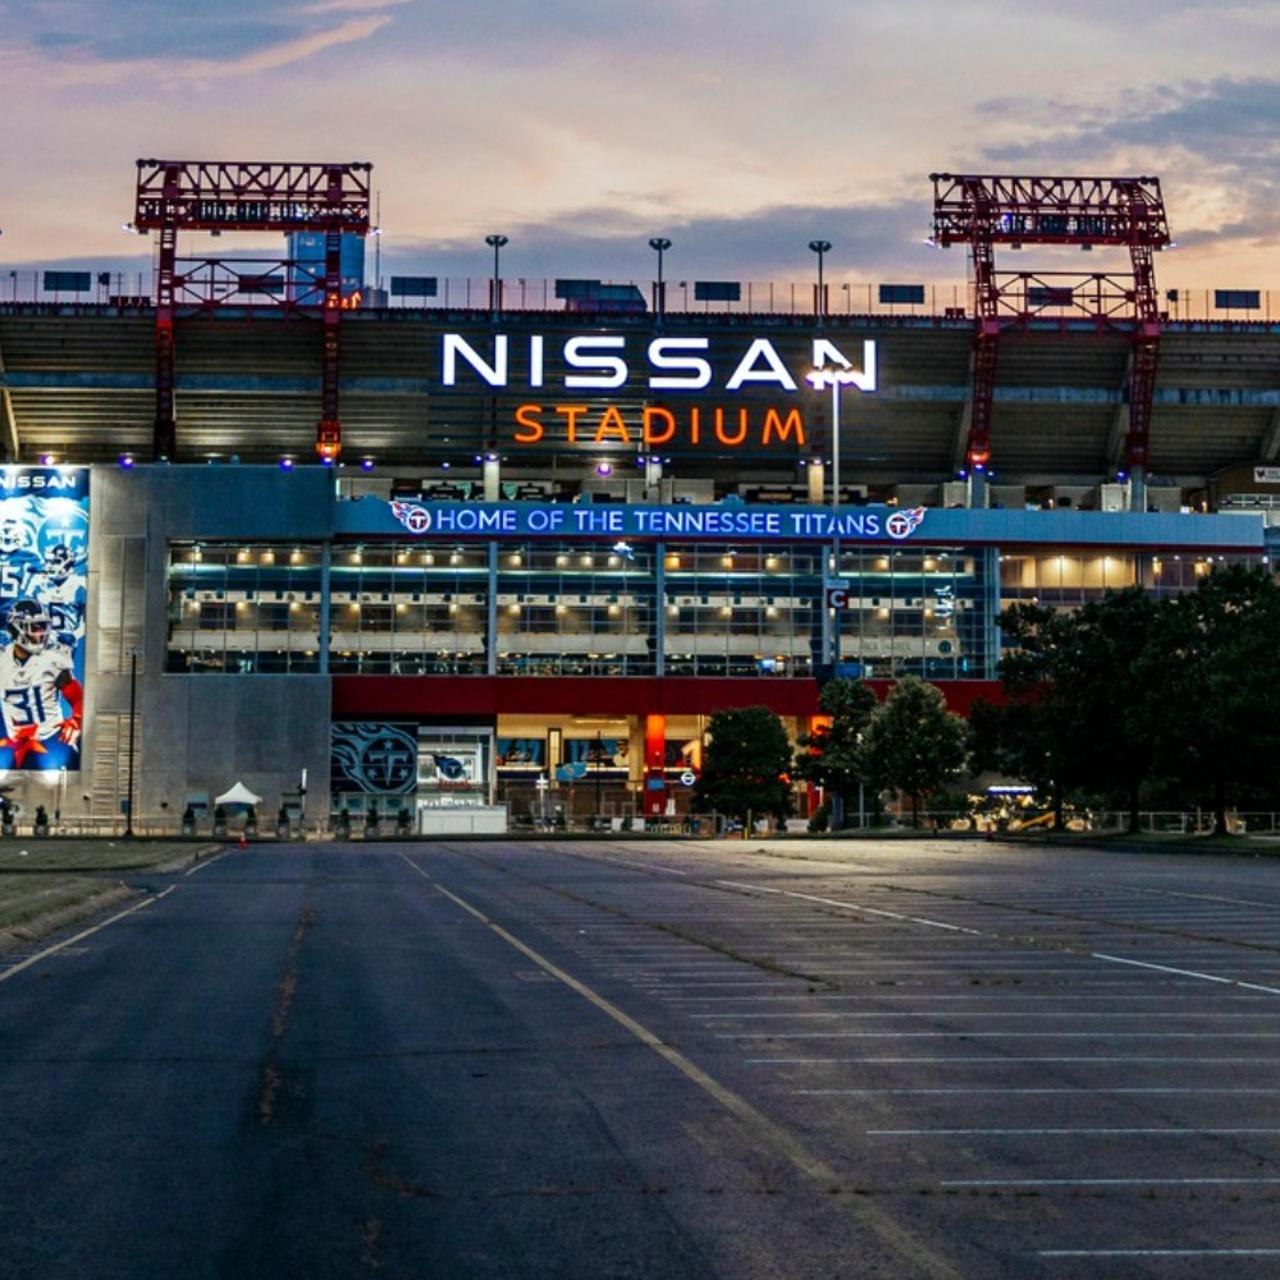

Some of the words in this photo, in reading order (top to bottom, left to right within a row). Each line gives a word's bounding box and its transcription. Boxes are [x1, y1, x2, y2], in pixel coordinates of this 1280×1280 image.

[442, 333, 878, 391] NISSAN
[513, 404, 806, 446] STADIUM
[436, 509, 517, 531] HOME
[527, 509, 564, 531] OF
[573, 510, 624, 532] THE
[633, 510, 781, 534] TENNESSEE
[790, 513, 880, 536] TITANS
[830, 590, 846, 608] C
[4, 685, 46, 727] 31
